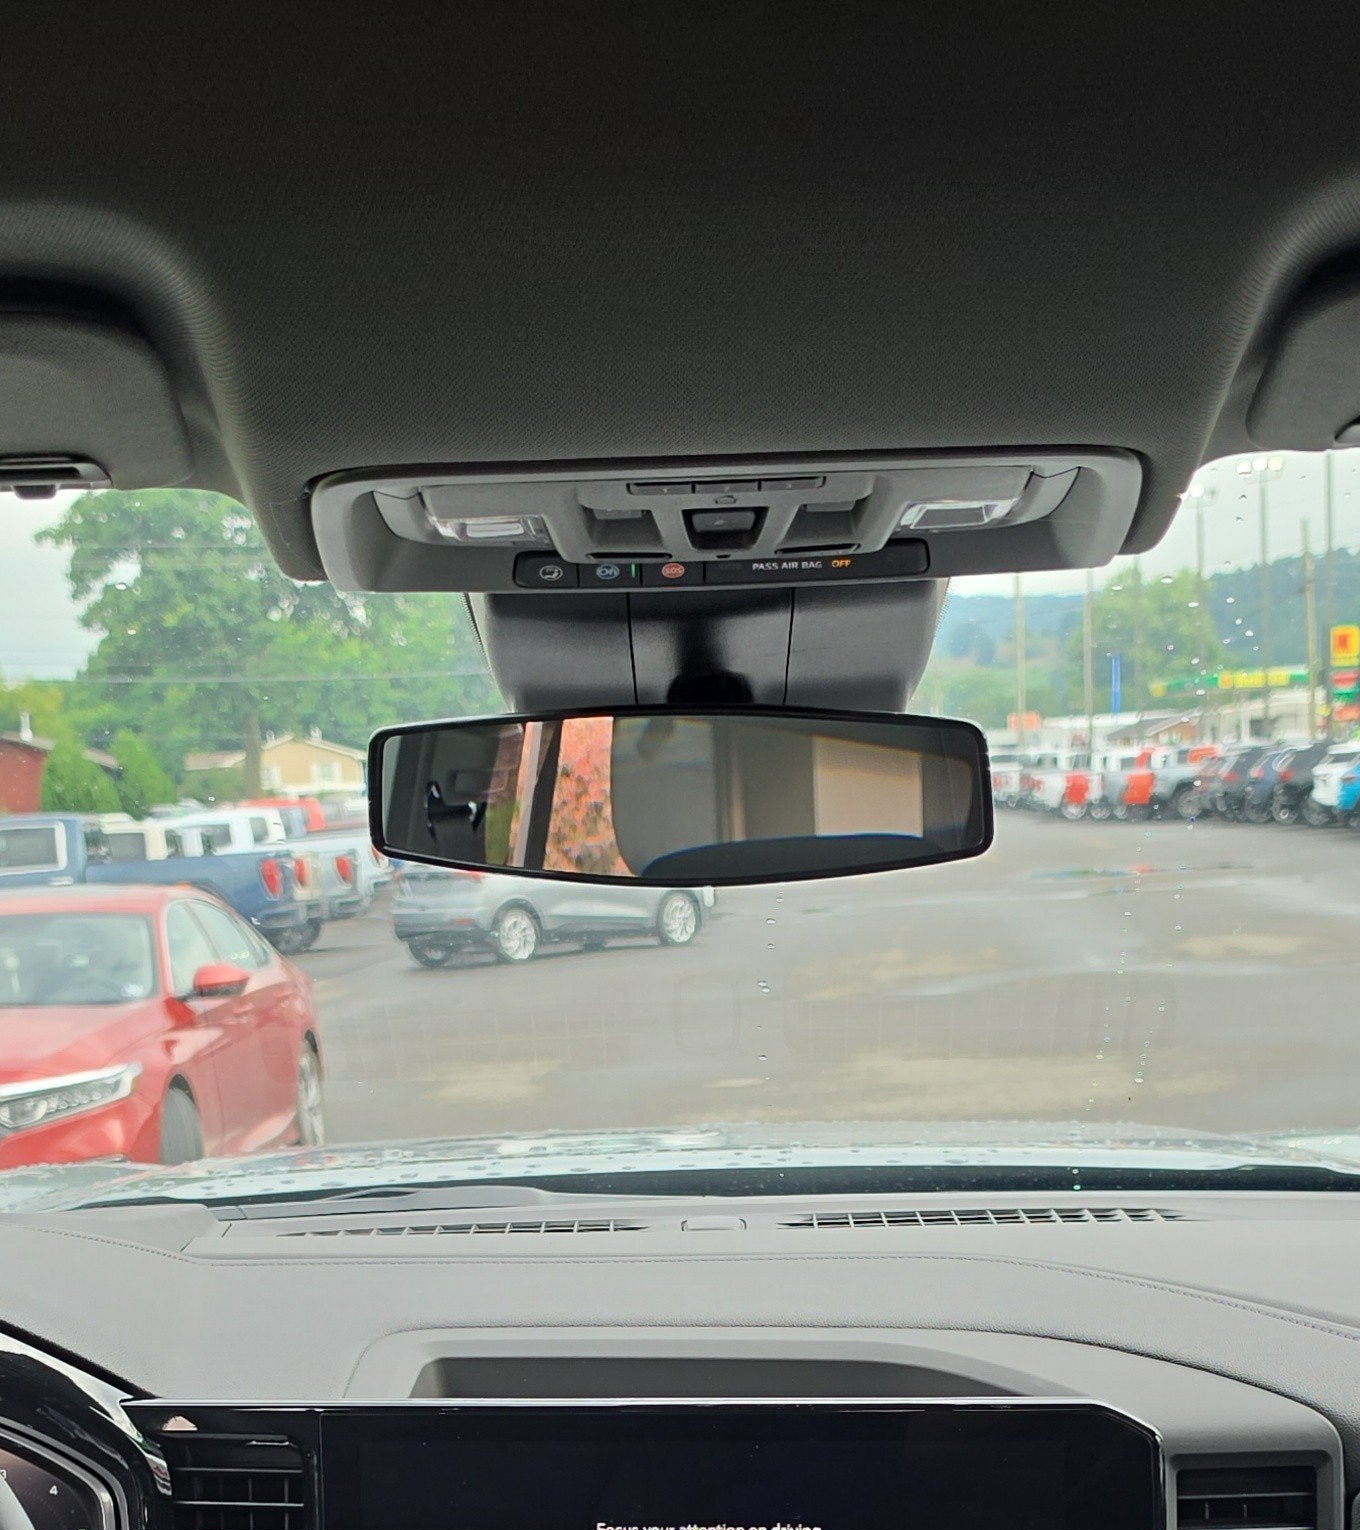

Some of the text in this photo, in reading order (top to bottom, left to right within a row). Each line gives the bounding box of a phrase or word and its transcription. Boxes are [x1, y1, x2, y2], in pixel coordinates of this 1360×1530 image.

[752, 558, 851, 571] PASS AIR BAG OFF
[49, 1485, 58, 1496] 4
